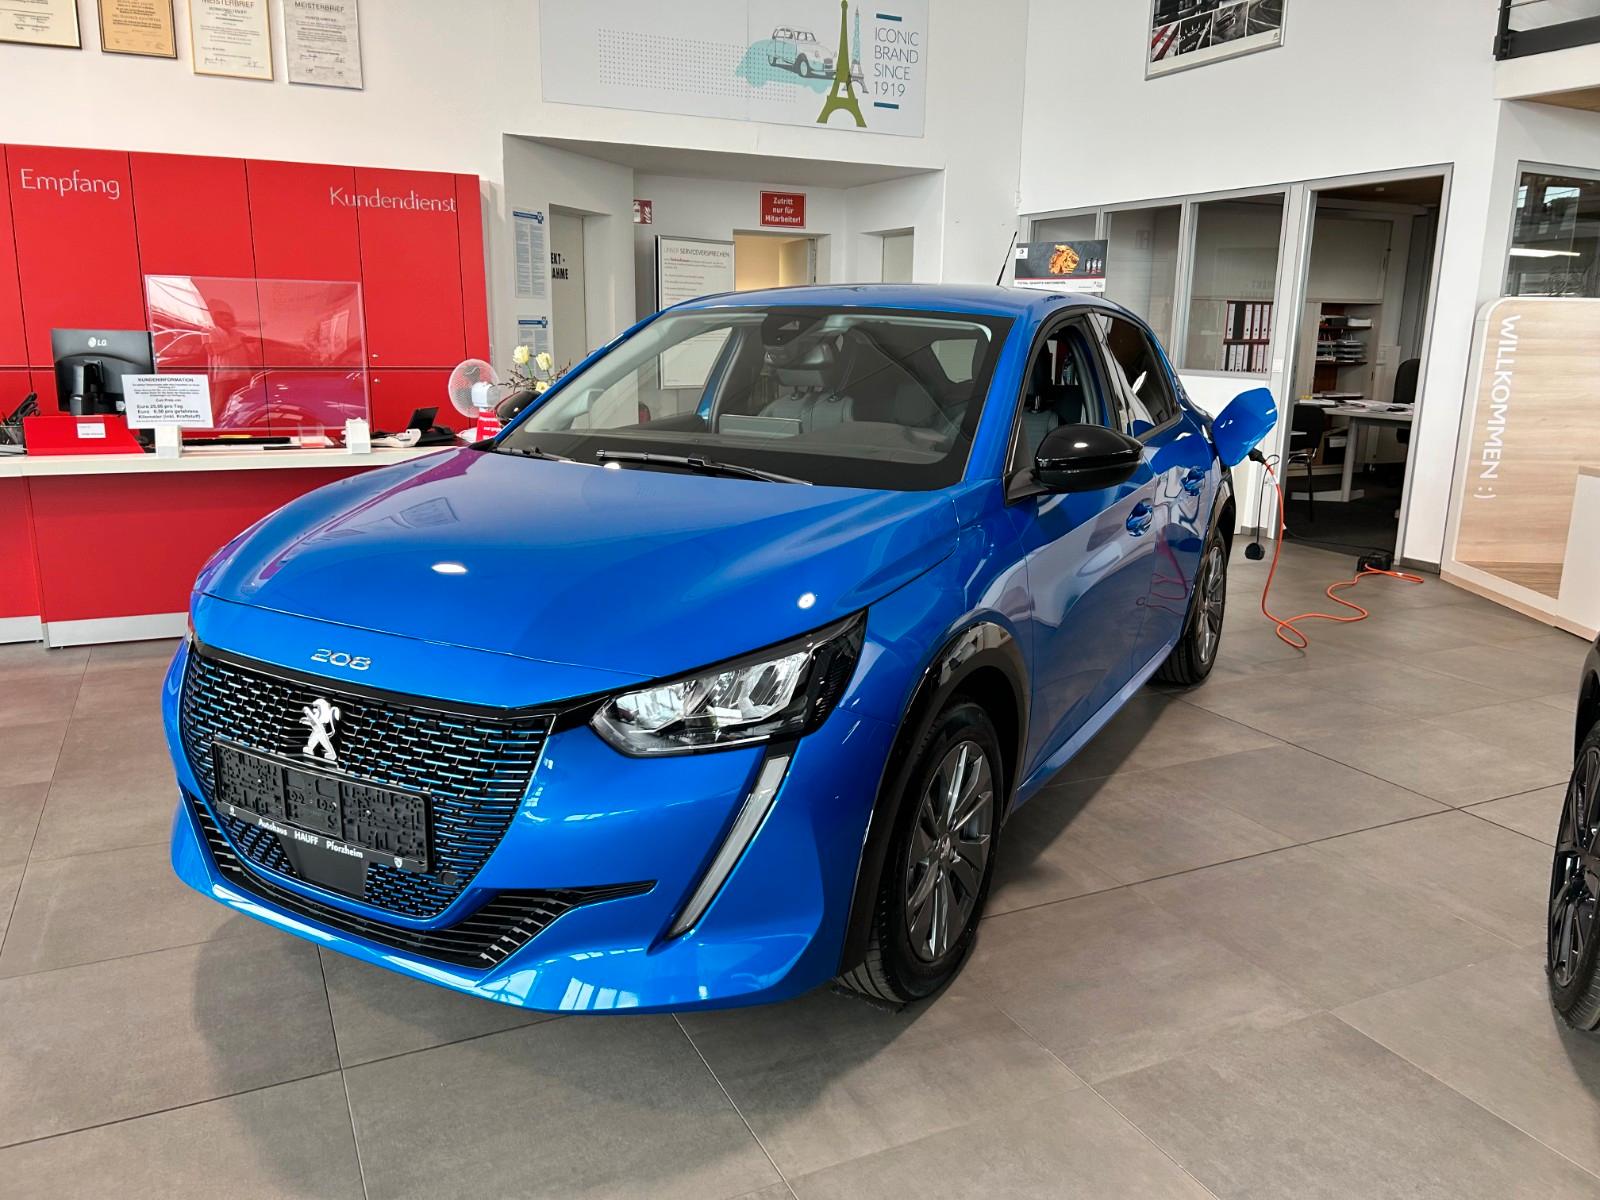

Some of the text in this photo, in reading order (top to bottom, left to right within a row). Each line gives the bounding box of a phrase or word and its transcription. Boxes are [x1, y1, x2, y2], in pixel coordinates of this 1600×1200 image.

[294, 1, 345, 13] MEISTERBRIEF
[875, 27, 919, 46] ICONIC
[874, 45, 919, 63] BRAND
[874, 63, 911, 80] SINCE
[874, 81, 906, 97] 1919
[20, 168, 120, 200] Empfang
[329, 186, 457, 213] Kundendienst
[773, 196, 794, 206] Zutritt
[785, 206, 795, 214] für
[765, 214, 801, 224] Mitarbeiter!
[97, 339, 108, 347] LG
[1480, 314, 1522, 480] WILLKOMMEN
[310, 648, 372, 671] 208
[257, 818, 364, 859] Autohaus HAUFF Pforzheim
